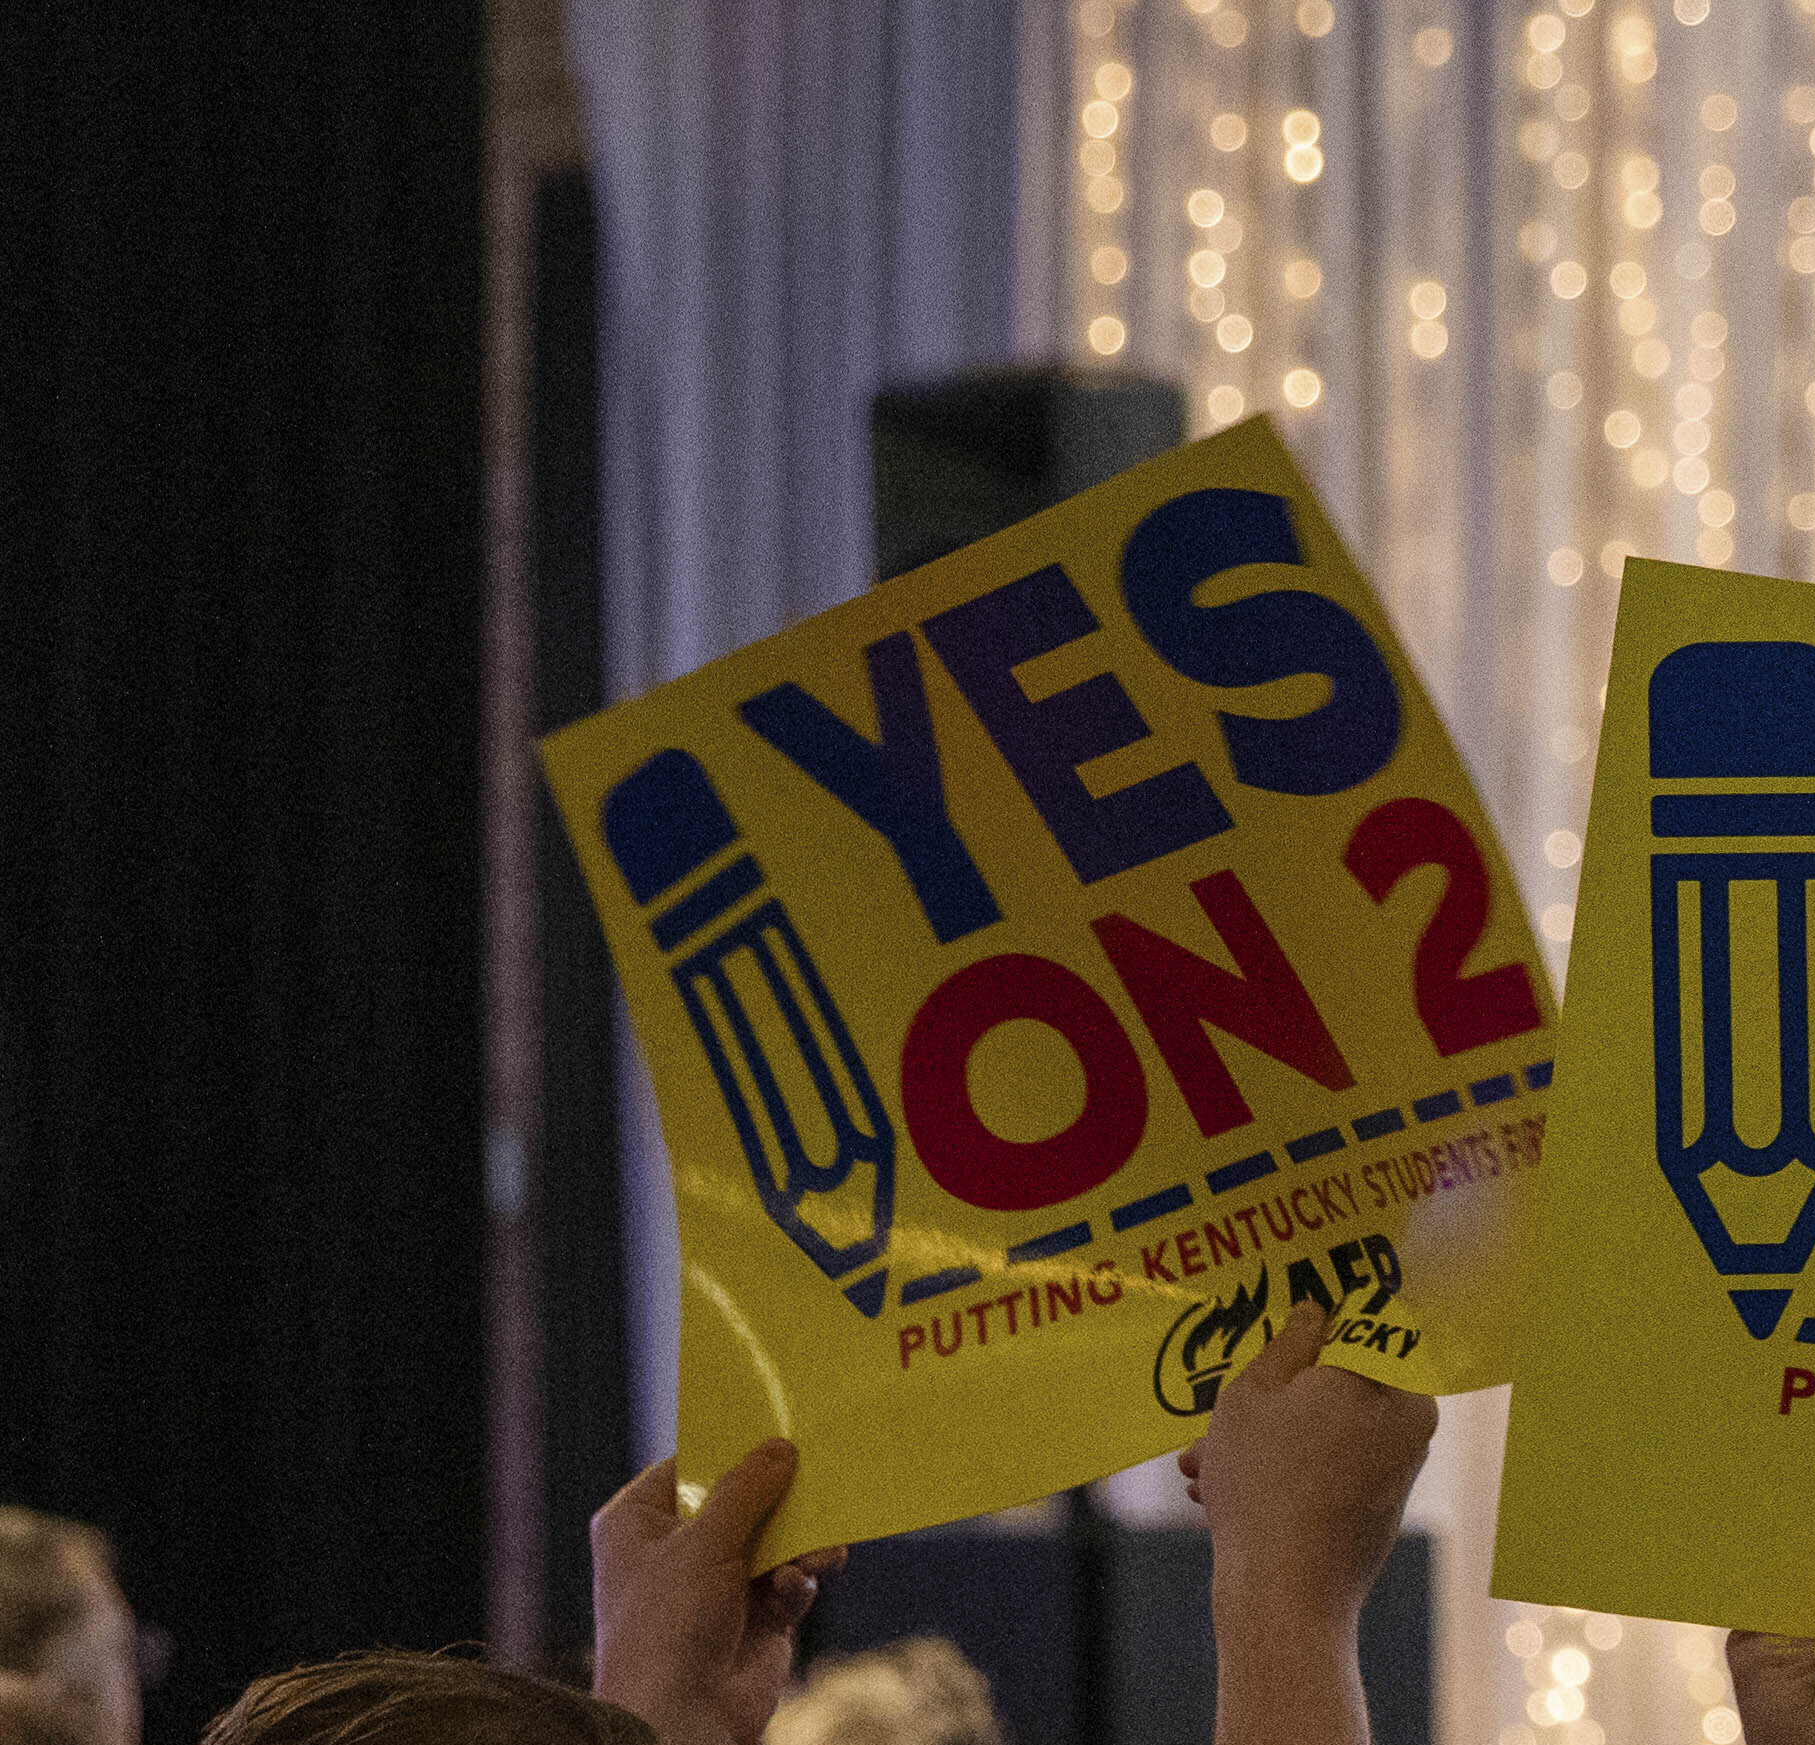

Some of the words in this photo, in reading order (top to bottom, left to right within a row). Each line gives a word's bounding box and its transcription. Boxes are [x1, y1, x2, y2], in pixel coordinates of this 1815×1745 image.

[737, 487, 1402, 943] YES
[899, 869, 1353, 1212] ON
[1343, 796, 1544, 1059] 2
[899, 1259, 1123, 1370] PUTTING
[1141, 1171, 1361, 1284] KENTUCKY
